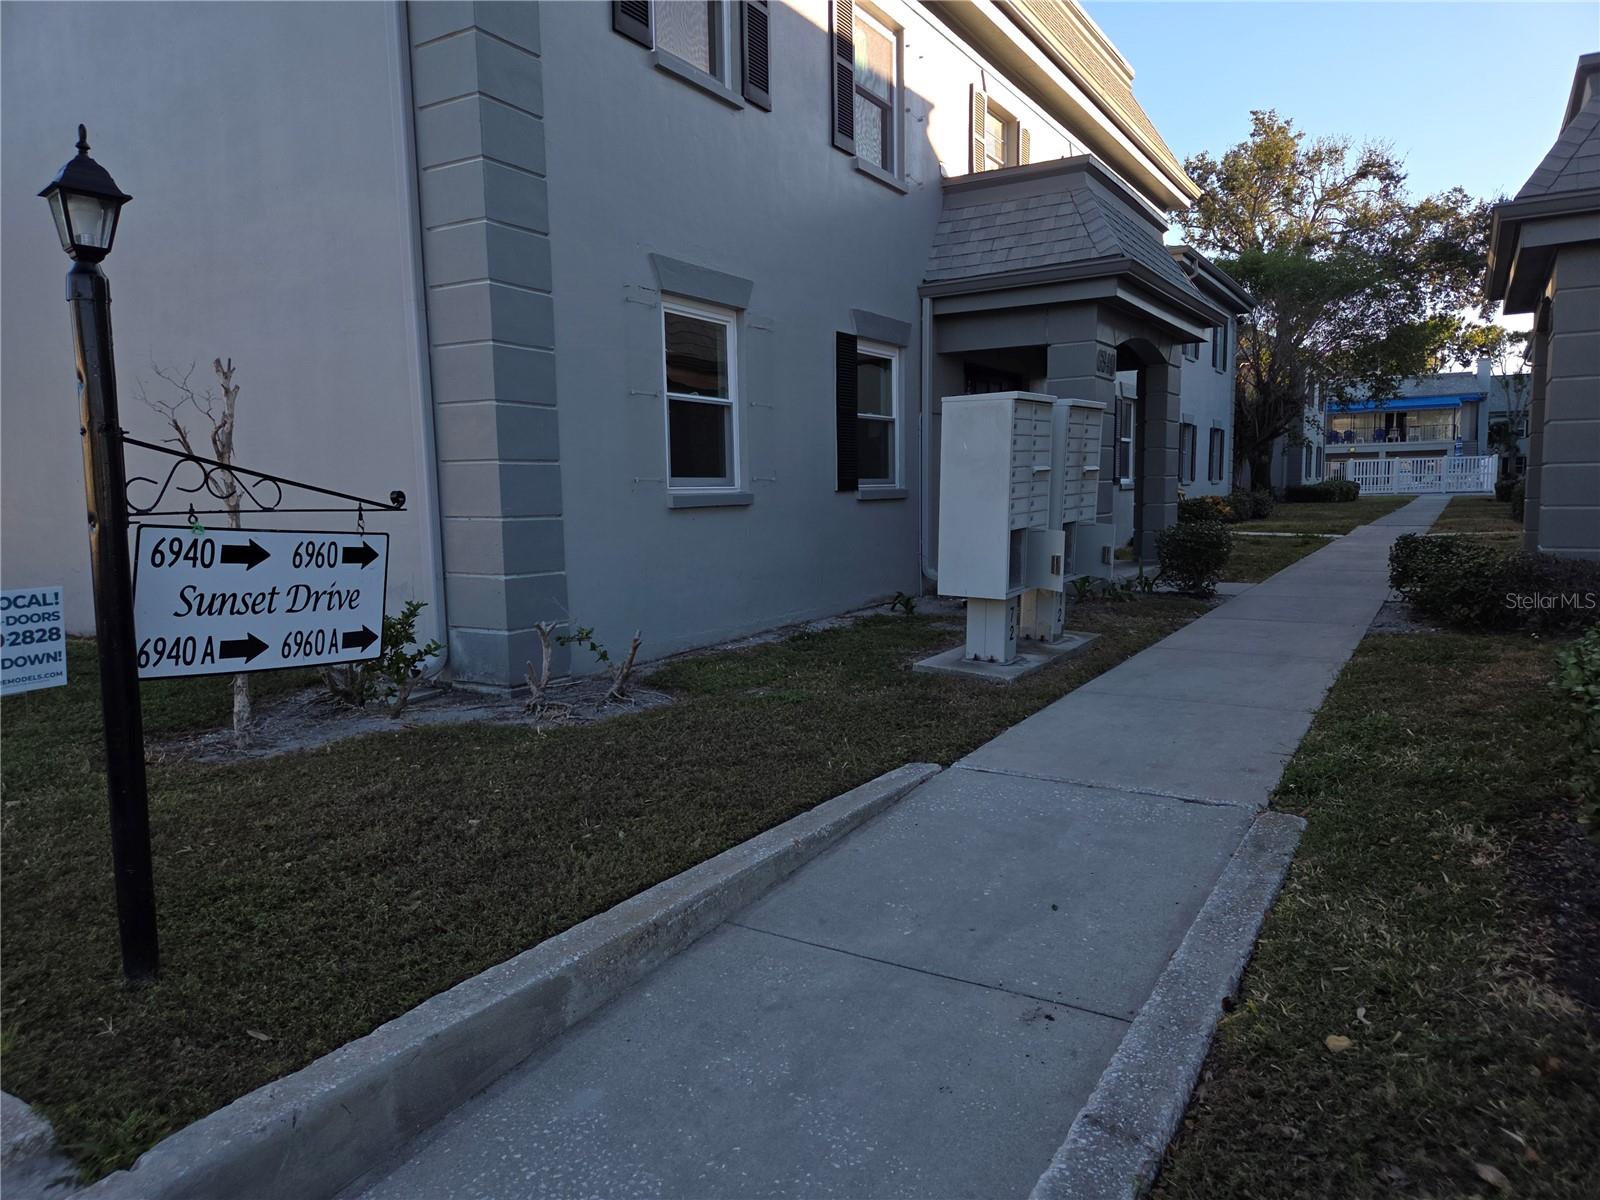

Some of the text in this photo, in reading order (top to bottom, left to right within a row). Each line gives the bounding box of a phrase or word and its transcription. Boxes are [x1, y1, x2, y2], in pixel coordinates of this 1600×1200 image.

[150, 536, 339, 569] 6940 6960
[173, 580, 361, 618] Sunset Drive
[1, 651, 63, 670] DOWN!
[0, 671, 63, 685] EMODELS.COM
